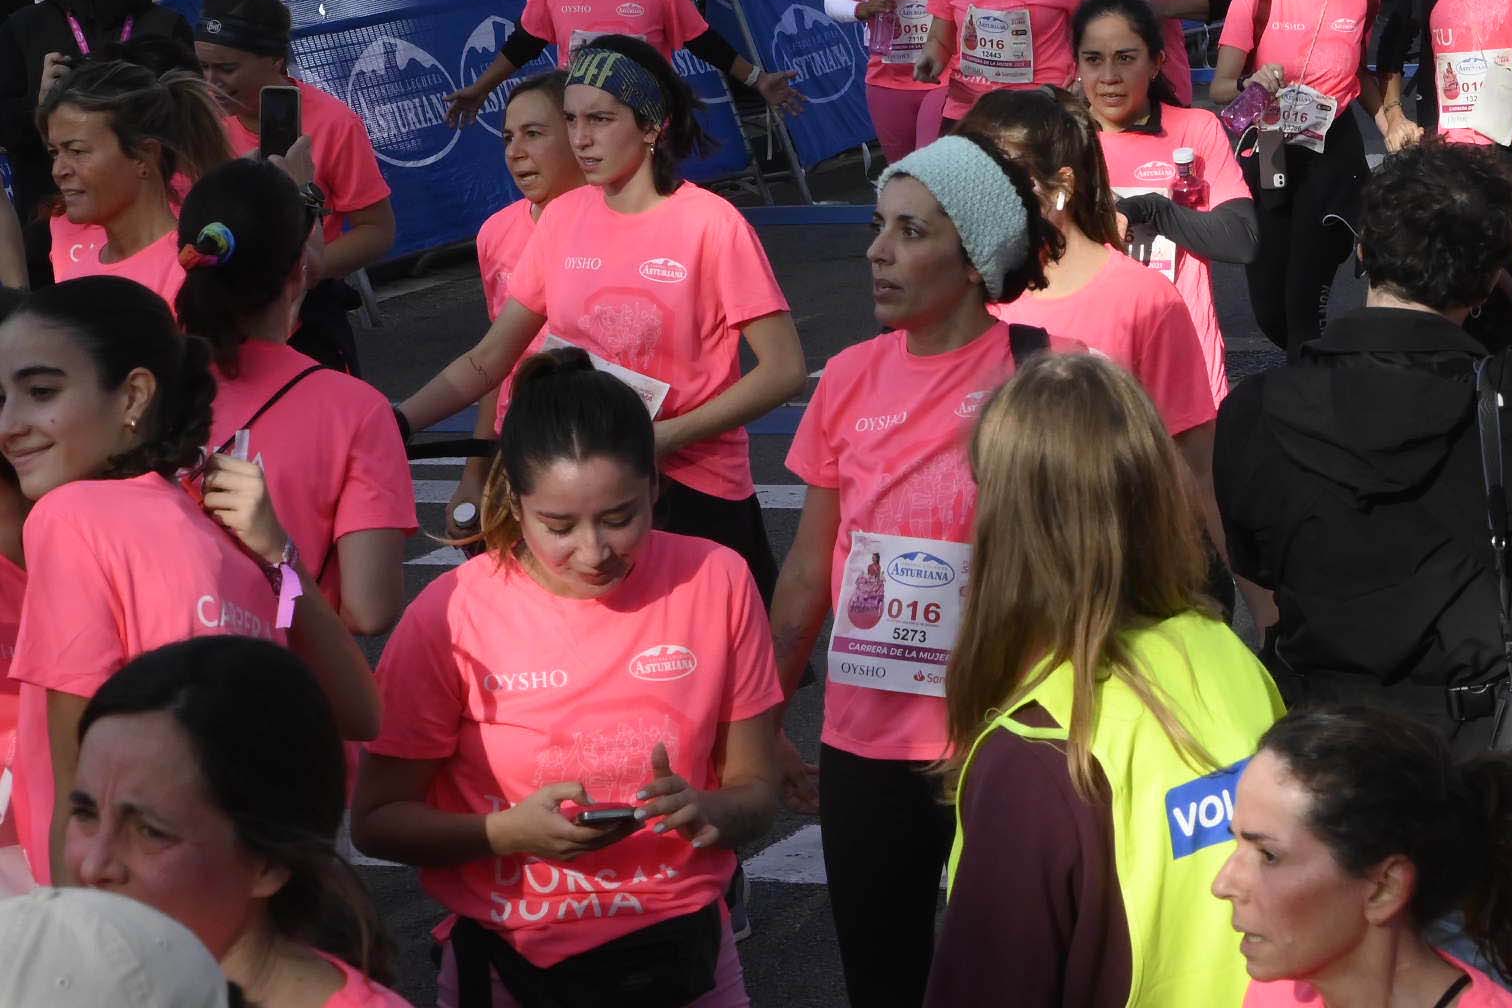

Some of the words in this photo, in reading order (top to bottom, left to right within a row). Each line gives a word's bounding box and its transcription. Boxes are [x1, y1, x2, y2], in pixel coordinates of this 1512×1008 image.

[561, 4, 592, 14] OYSHO
[979, 37, 1005, 50] 016
[1433, 28, 1453, 46] TU
[1282, 110, 1308, 123] 016
[565, 256, 602, 271] OYSHO
[855, 409, 908, 432] OYSHO
[891, 563, 949, 582] ASTURIANA
[887, 599, 942, 624] 016
[892, 627, 927, 643] 5273
[848, 641, 889, 656] CARRERA
[889, 647, 903, 657] DE
[904, 648, 918, 659] LA
[635, 659, 694, 676] ASTURIANA
[840, 661, 886, 679] OYSHO
[483, 669, 568, 692] OYSHO
